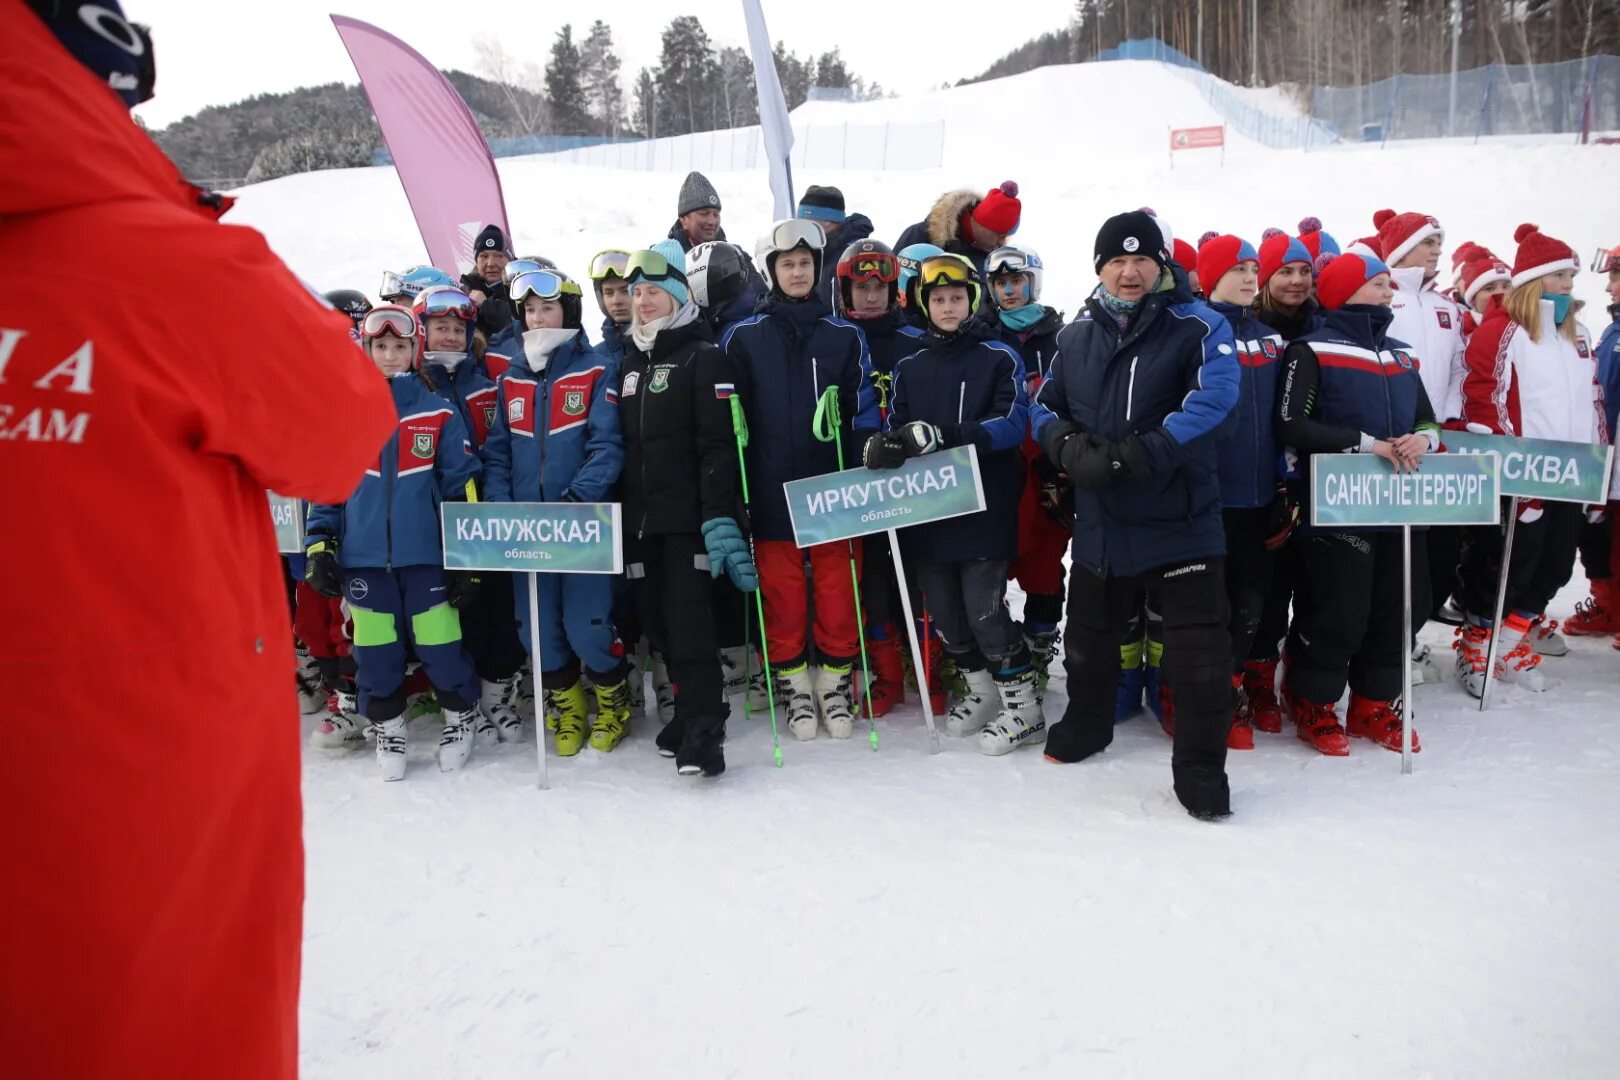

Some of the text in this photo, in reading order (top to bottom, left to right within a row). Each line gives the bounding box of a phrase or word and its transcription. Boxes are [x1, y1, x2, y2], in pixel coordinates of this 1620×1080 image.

[687, 265, 707, 277] EAD
[897, 256, 917, 269] vex
[806, 464, 958, 516] ИРКУТСКАЯ
[1325, 473, 1488, 505] САНКТ-ПЕТЕРБУРГ
[861, 505, 912, 522] область
[456, 518, 601, 543] КАЛУЖСКАЯ
[504, 549, 552, 560] область
[1009, 721, 1045, 744] HEAD
